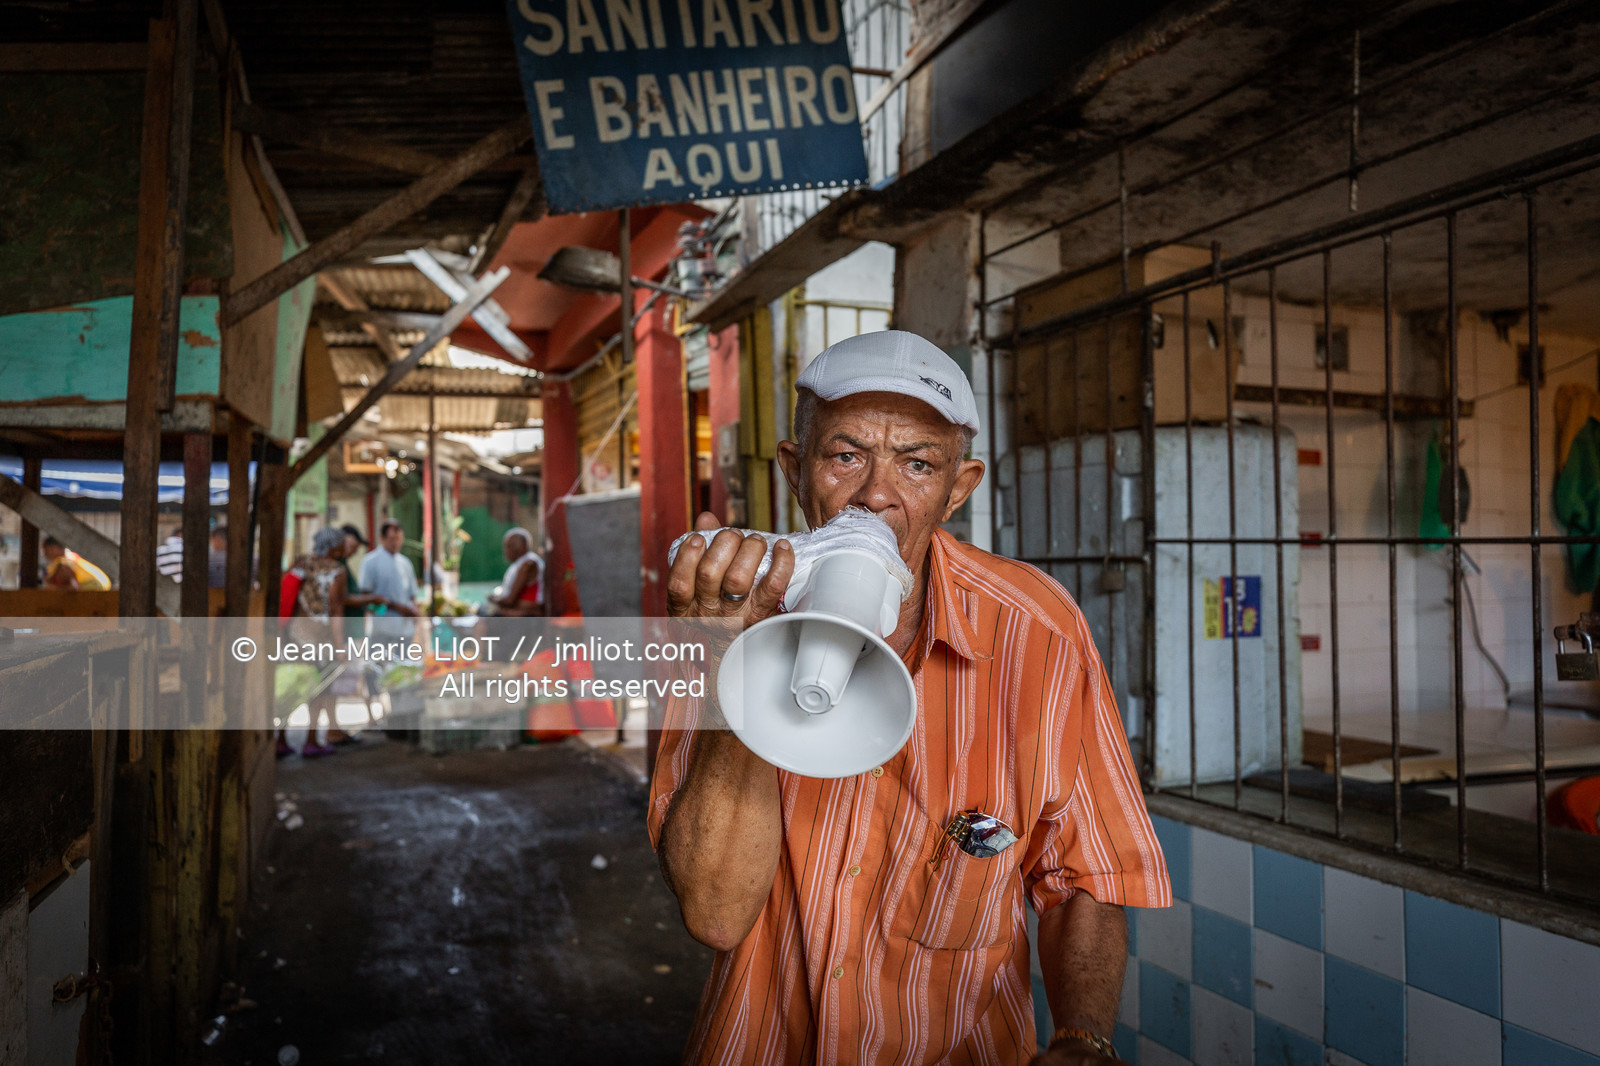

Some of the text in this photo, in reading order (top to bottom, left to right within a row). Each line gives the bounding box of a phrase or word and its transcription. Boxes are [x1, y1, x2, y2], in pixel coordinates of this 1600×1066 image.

[534, 64, 857, 149] E BANHEIRO
[643, 138, 784, 191] AQUI
